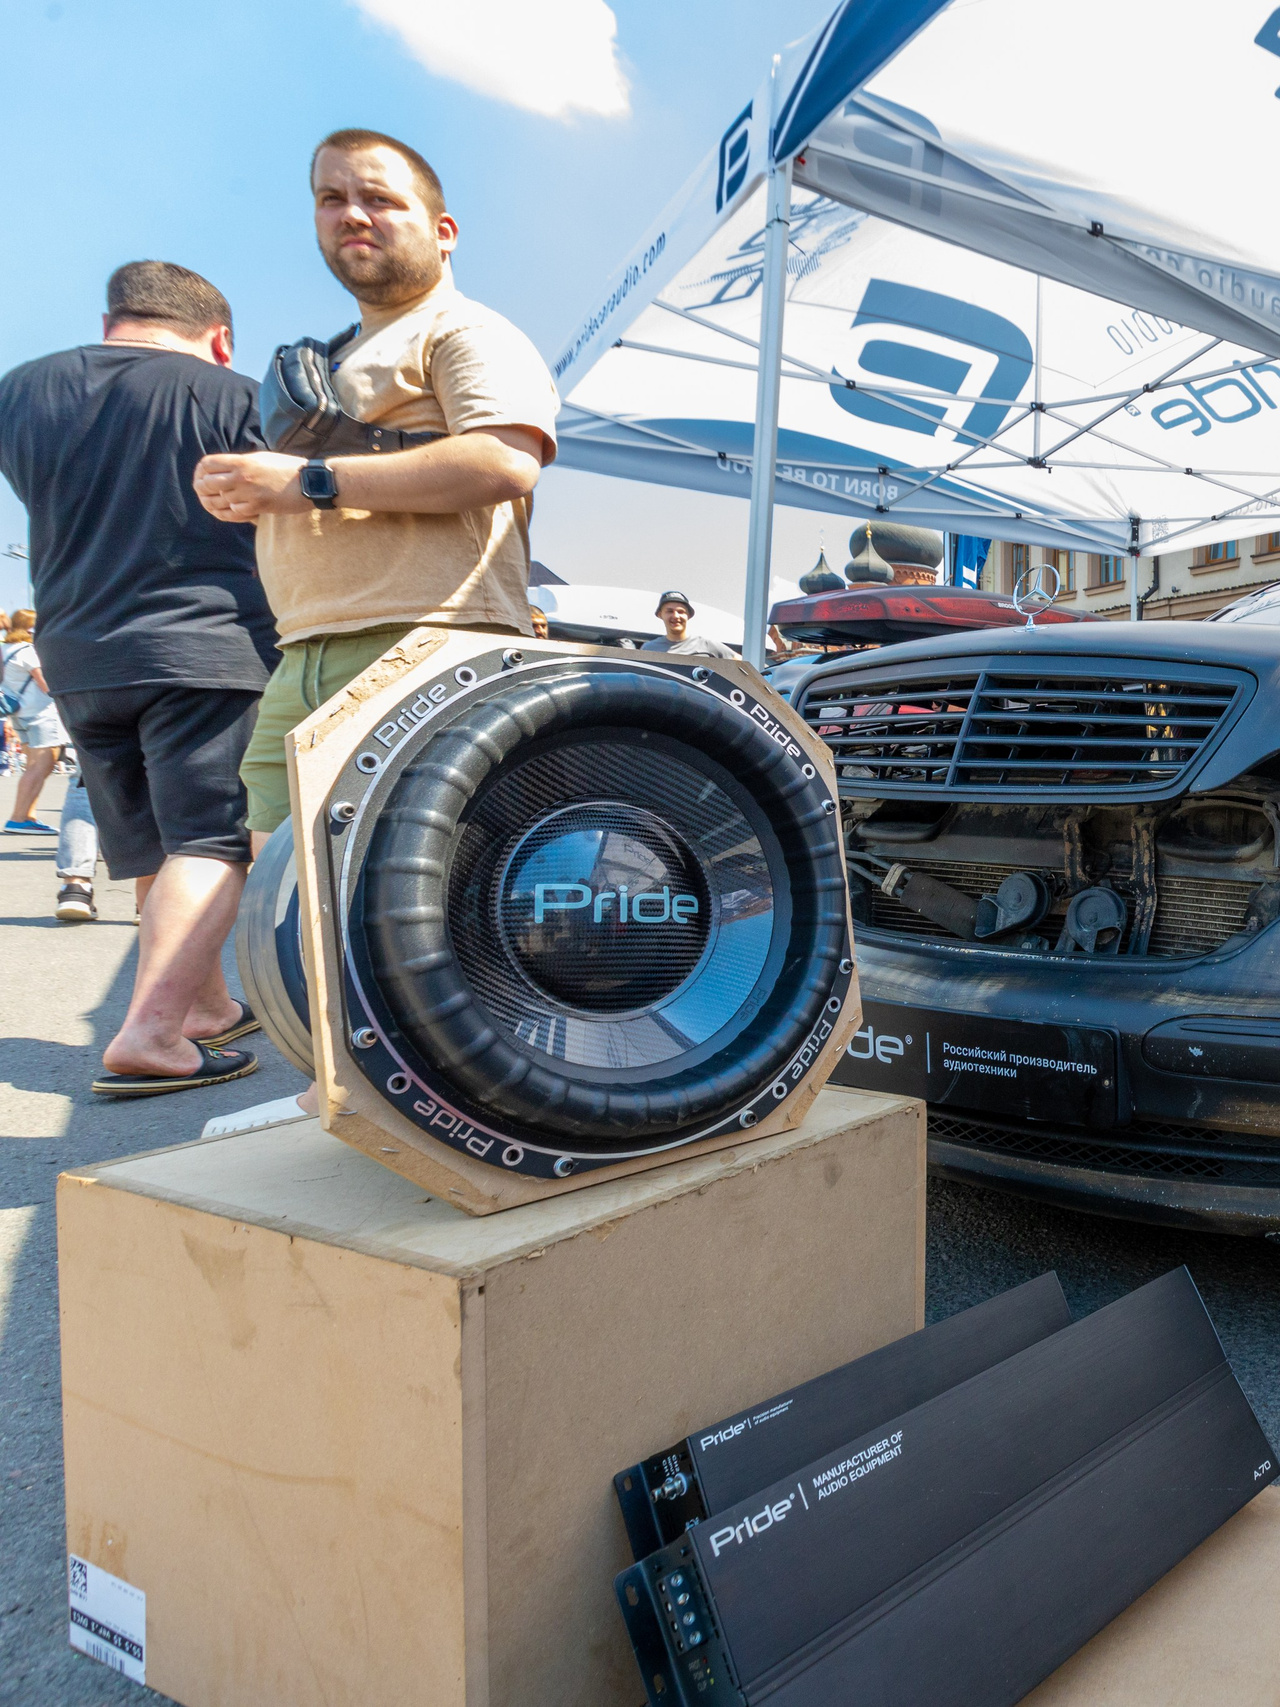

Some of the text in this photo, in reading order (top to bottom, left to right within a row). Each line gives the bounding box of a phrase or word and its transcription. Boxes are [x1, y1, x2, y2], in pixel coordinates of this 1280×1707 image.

[373, 683, 447, 748] Pride
[750, 703, 801, 758] Pride
[534, 883, 699, 924] Pride
[791, 1019, 833, 1080] Pride
[942, 1041, 1098, 1076] Российский производитель
[942, 1058, 1017, 1079] аудиотехники
[413, 1099, 495, 1157] Pride
[812, 1430, 904, 1489] MANUFACTURER OF
[817, 1444, 903, 1501] AUDIO EQUIPMENT
